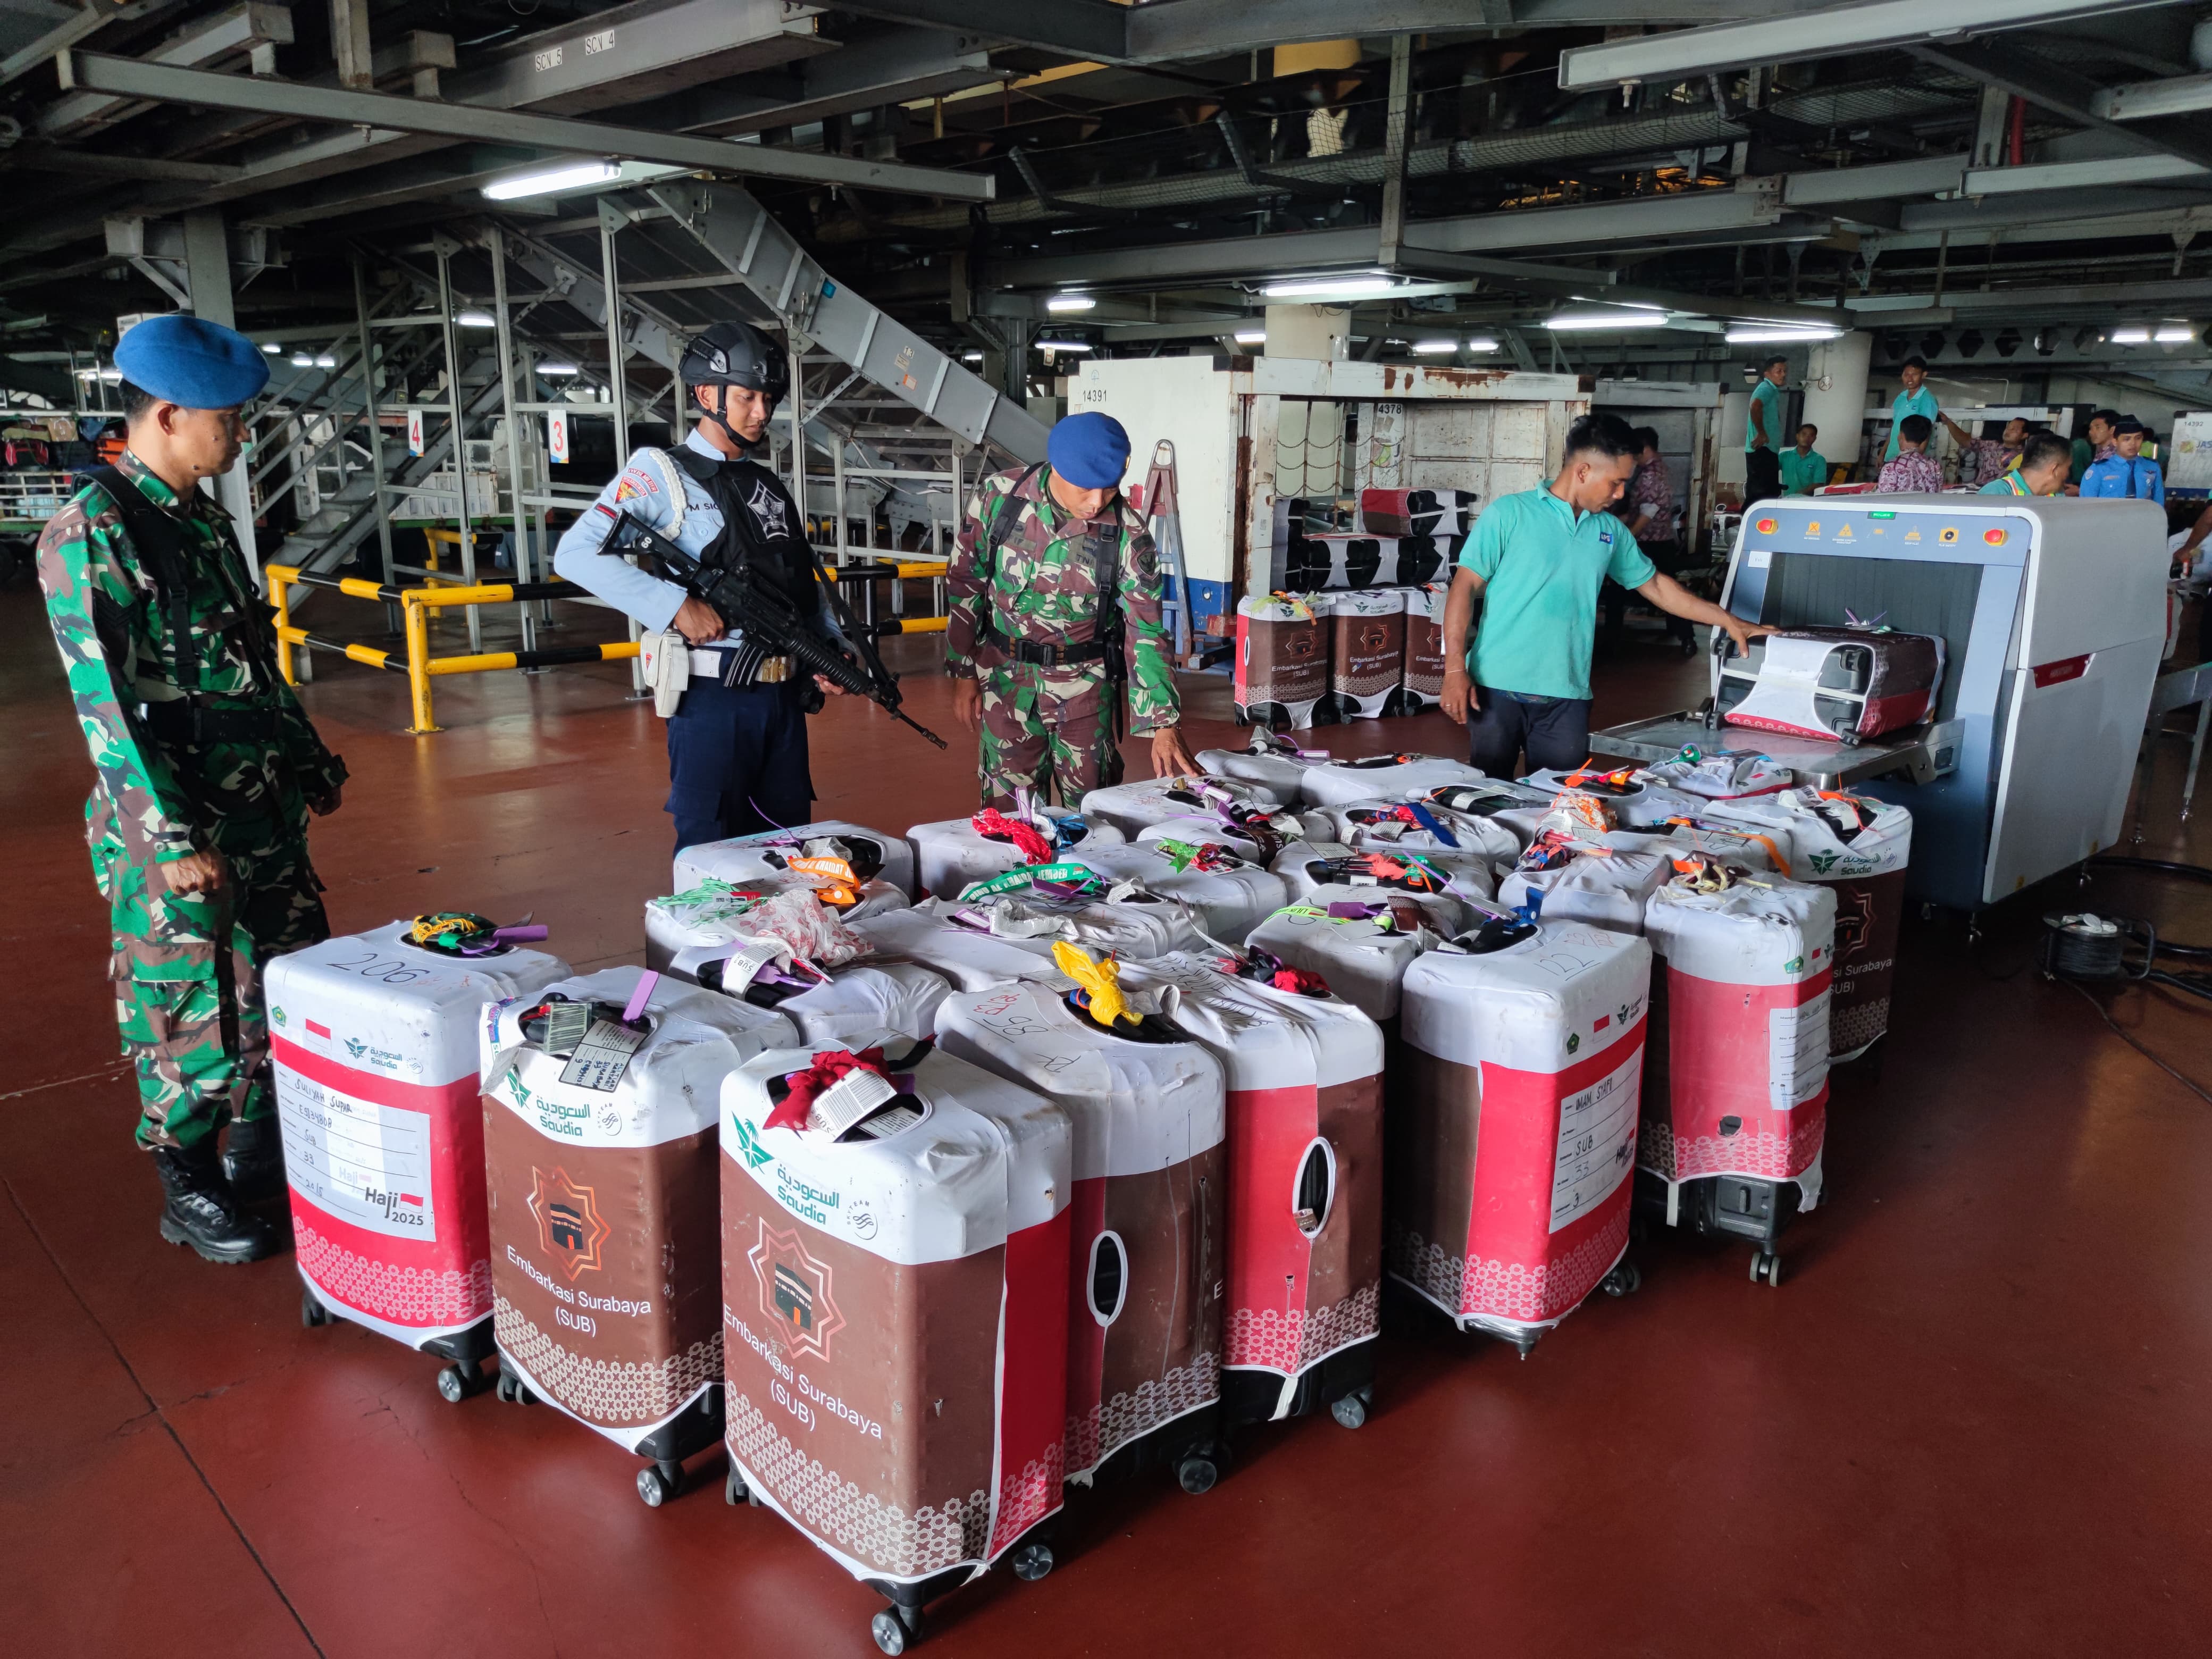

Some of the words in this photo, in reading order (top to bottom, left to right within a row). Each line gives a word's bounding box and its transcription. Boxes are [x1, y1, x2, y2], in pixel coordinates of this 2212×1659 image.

[586, 35, 602, 54] SCV
[609, 32, 614, 47] 4
[536, 52, 551, 71] SCV
[557, 49, 562, 64] 5
[1083, 390, 1107, 402] 14391
[1378, 404, 1402, 414] 4378
[412, 420, 420, 447] 4
[554, 421, 564, 452] 3
[1840, 865, 1872, 875] Saudia
[326, 953, 430, 983] 206
[738, 959, 754, 972] SUB
[1845, 958, 1892, 976] Surabaya
[370, 1046, 403, 1062] السعودية
[371, 1056, 398, 1070] Saudia
[295, 1078, 325, 1103] SULIYAH
[537, 1095, 591, 1120] السعودية
[540, 1115, 583, 1136] Saudia
[1576, 1134, 1593, 1156] SUB
[777, 1163, 840, 1209] السعودية
[365, 1186, 398, 1219] Haji
[777, 1185, 826, 1225] Saudia
[847, 1200, 870, 1225] SKYTEAM
[391, 1211, 424, 1226] 2025
[507, 1244, 575, 1304] Embarkasi
[578, 1291, 651, 1317] Surabaya
[556, 1305, 597, 1337] (SUB)
[724, 1303, 794, 1385] Embarkasi
[798, 1373, 882, 1440] Surabaya
[771, 1378, 816, 1432] (SUB)
